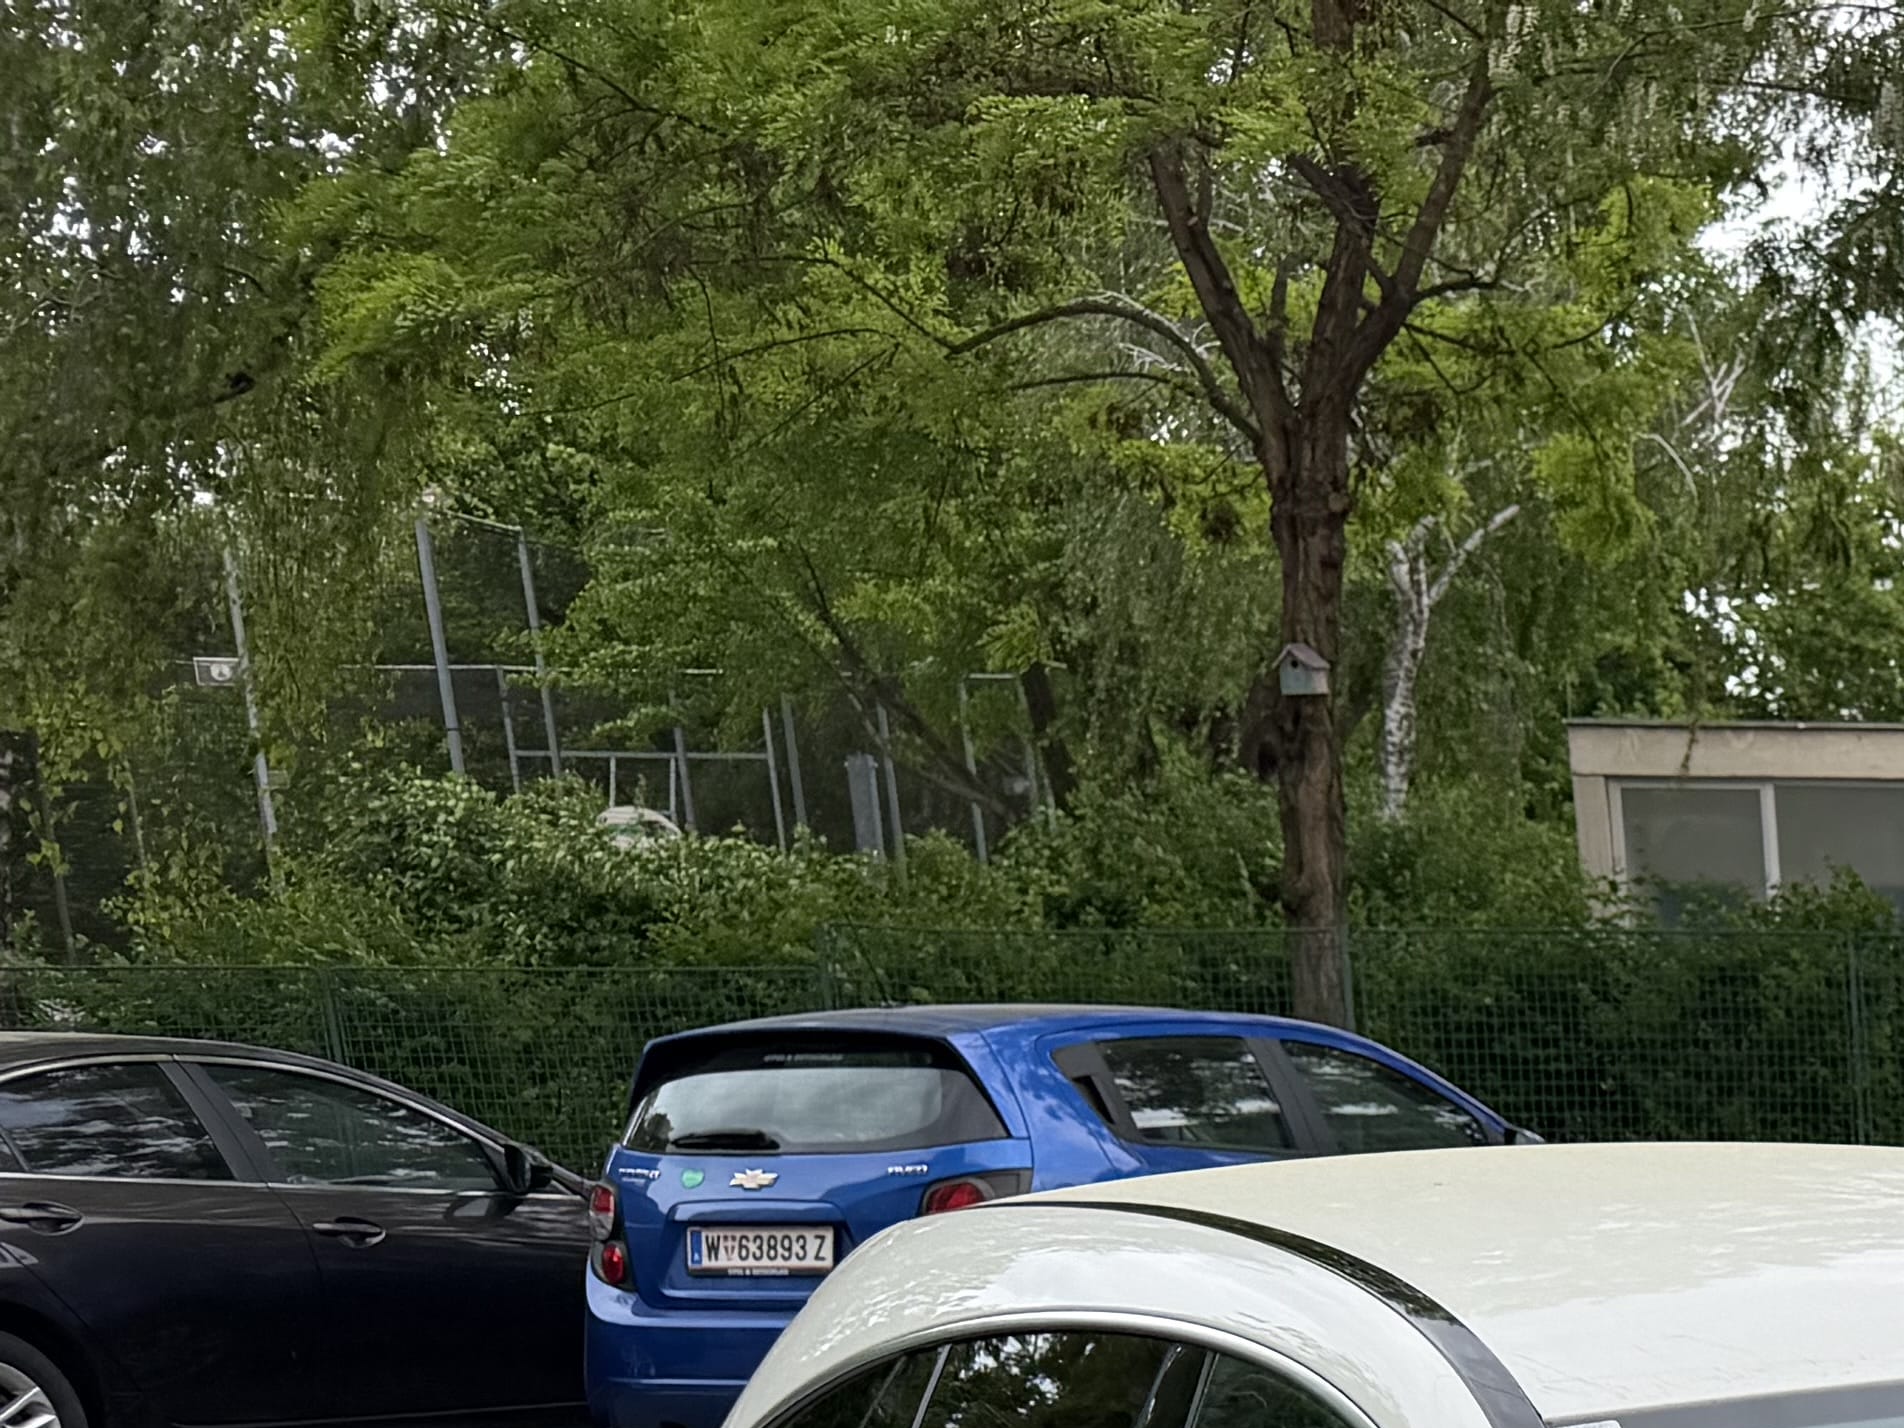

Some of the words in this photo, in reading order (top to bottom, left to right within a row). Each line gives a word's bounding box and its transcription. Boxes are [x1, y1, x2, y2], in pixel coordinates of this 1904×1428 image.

[705, 1234, 721, 1262] W
[738, 1234, 807, 1262] 63893
[813, 1234, 827, 1261] Z
